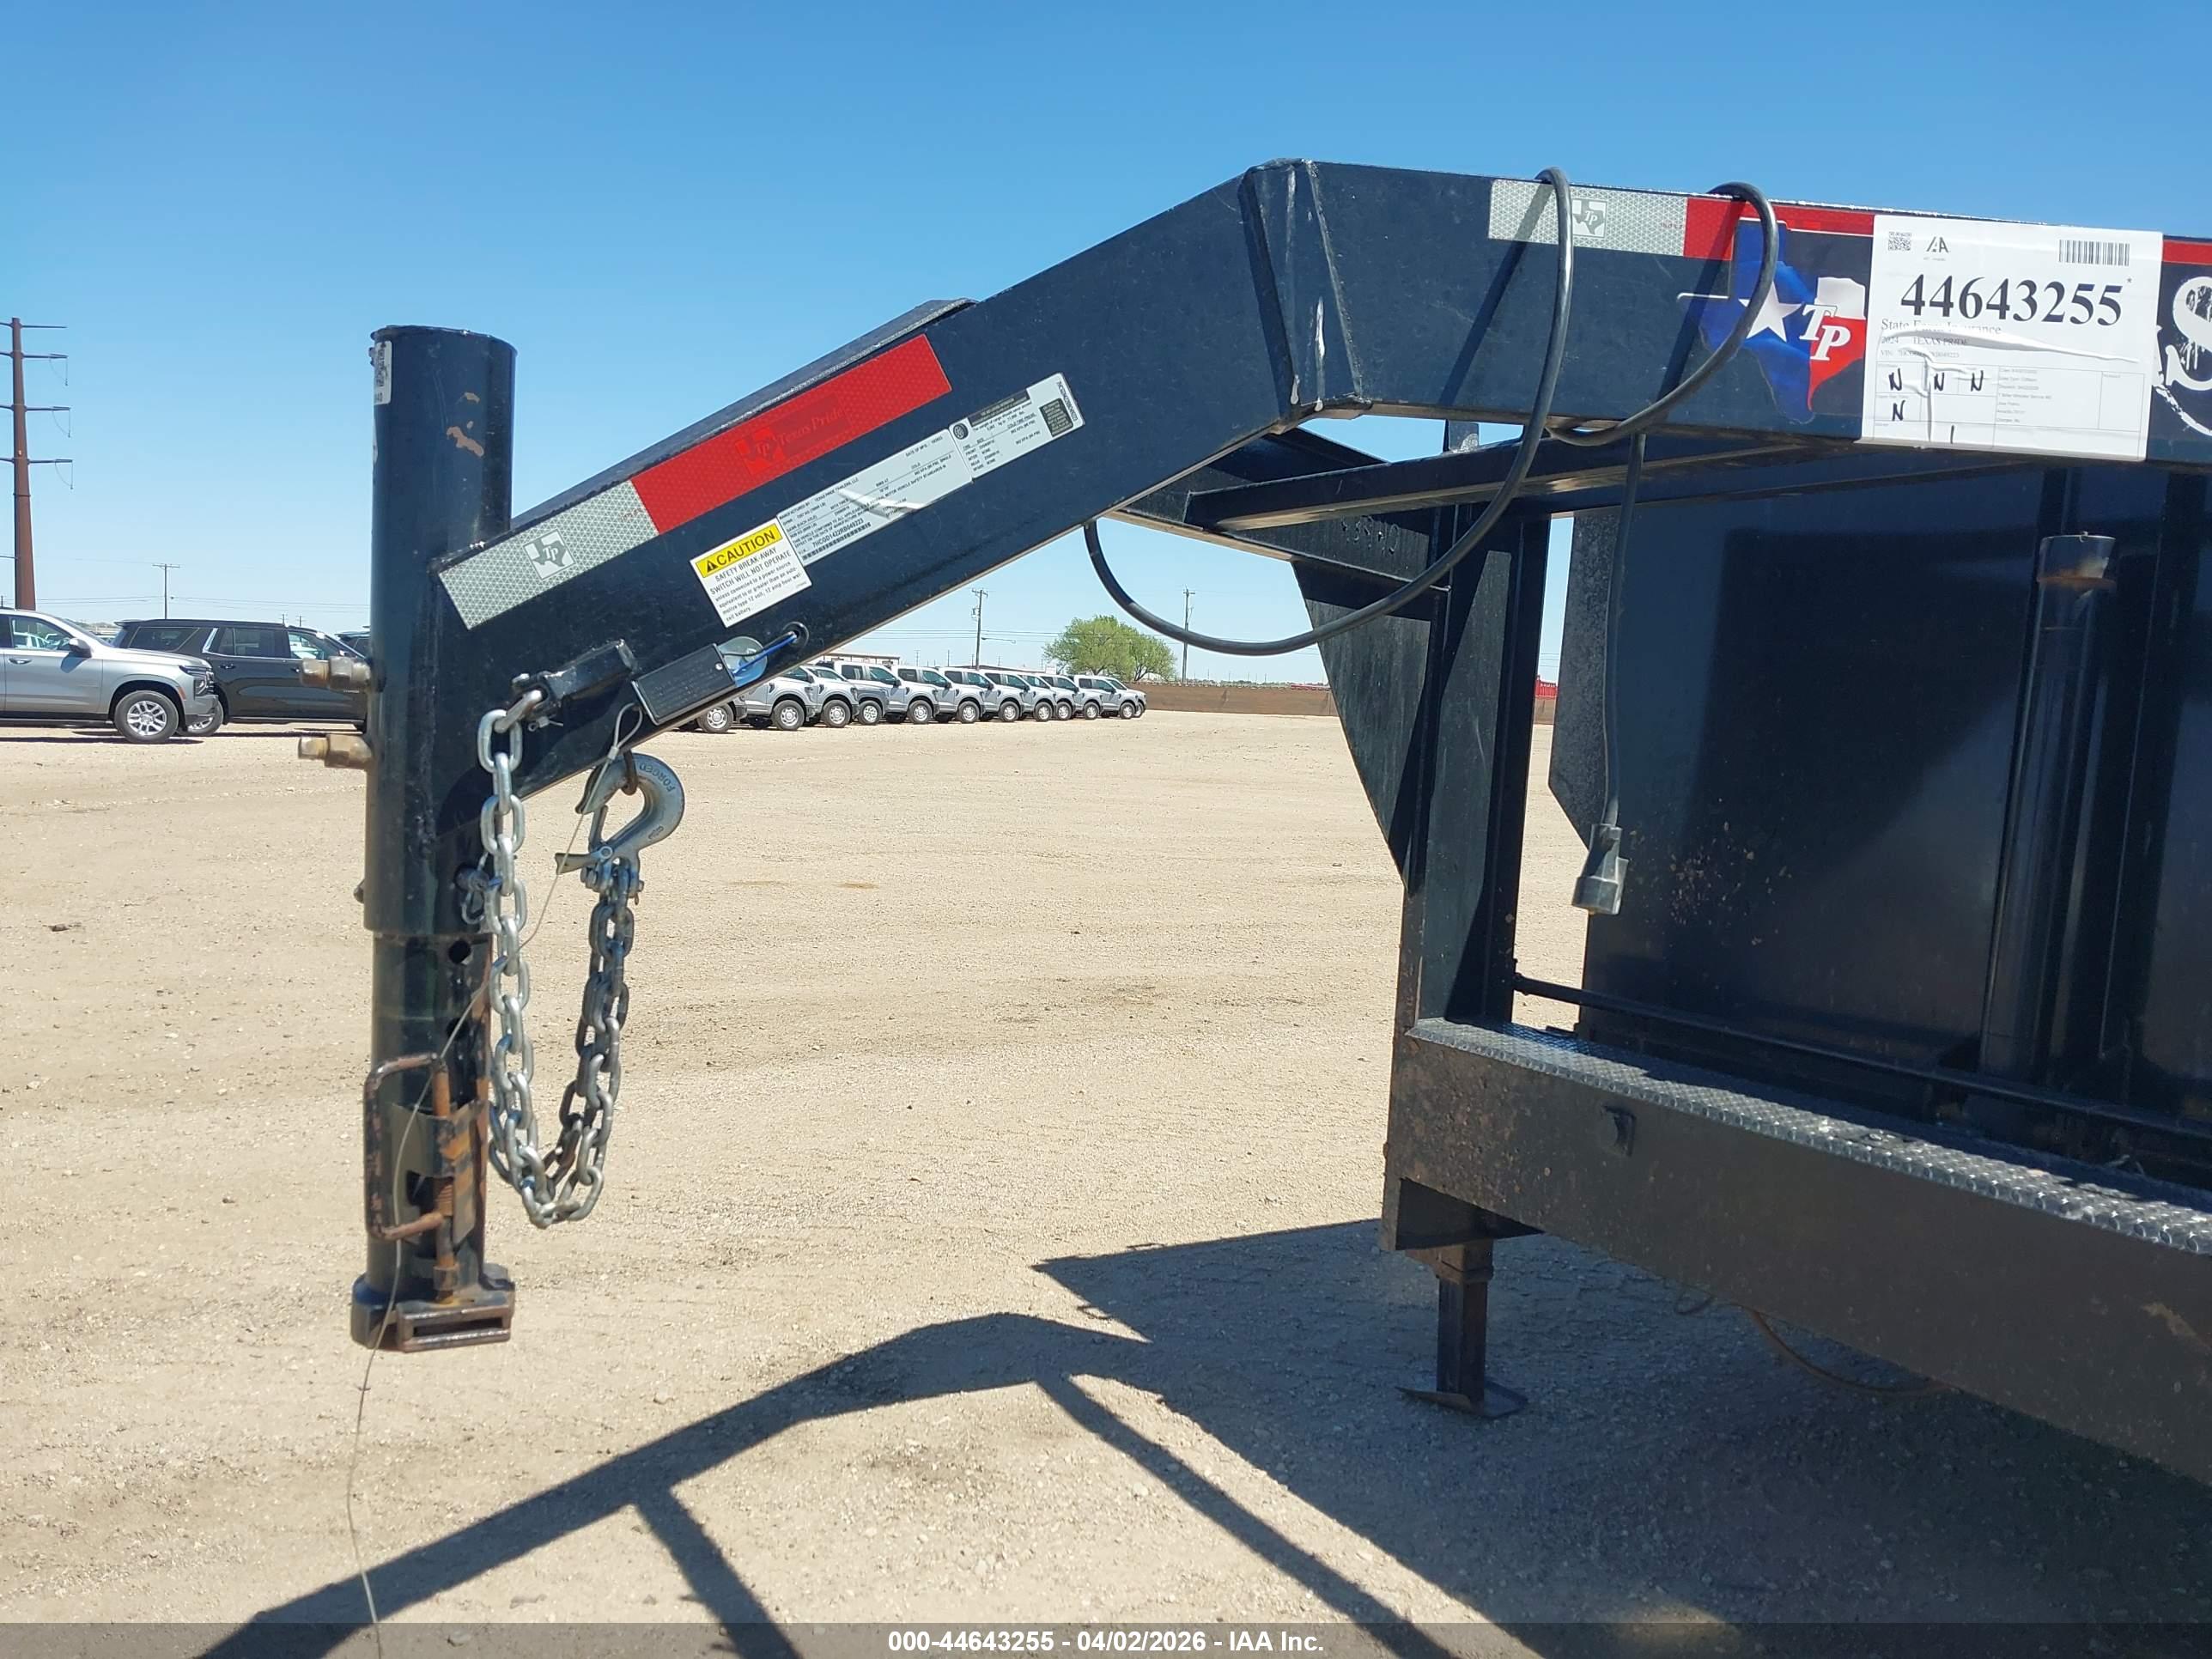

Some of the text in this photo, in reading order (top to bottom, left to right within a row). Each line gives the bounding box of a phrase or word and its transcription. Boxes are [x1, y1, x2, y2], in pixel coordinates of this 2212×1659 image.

[1900, 273, 2124, 326] 44643255
[1800, 304, 1851, 362] TP
[716, 529, 775, 566] CAUTION
[709, 578, 735, 595] SWITCH
[733, 570, 750, 582] WILL
[750, 563, 763, 574] NOT
[763, 550, 791, 568] OPERATE
[714, 566, 738, 582] SAFETY
[639, 763, 676, 793] FORGED
